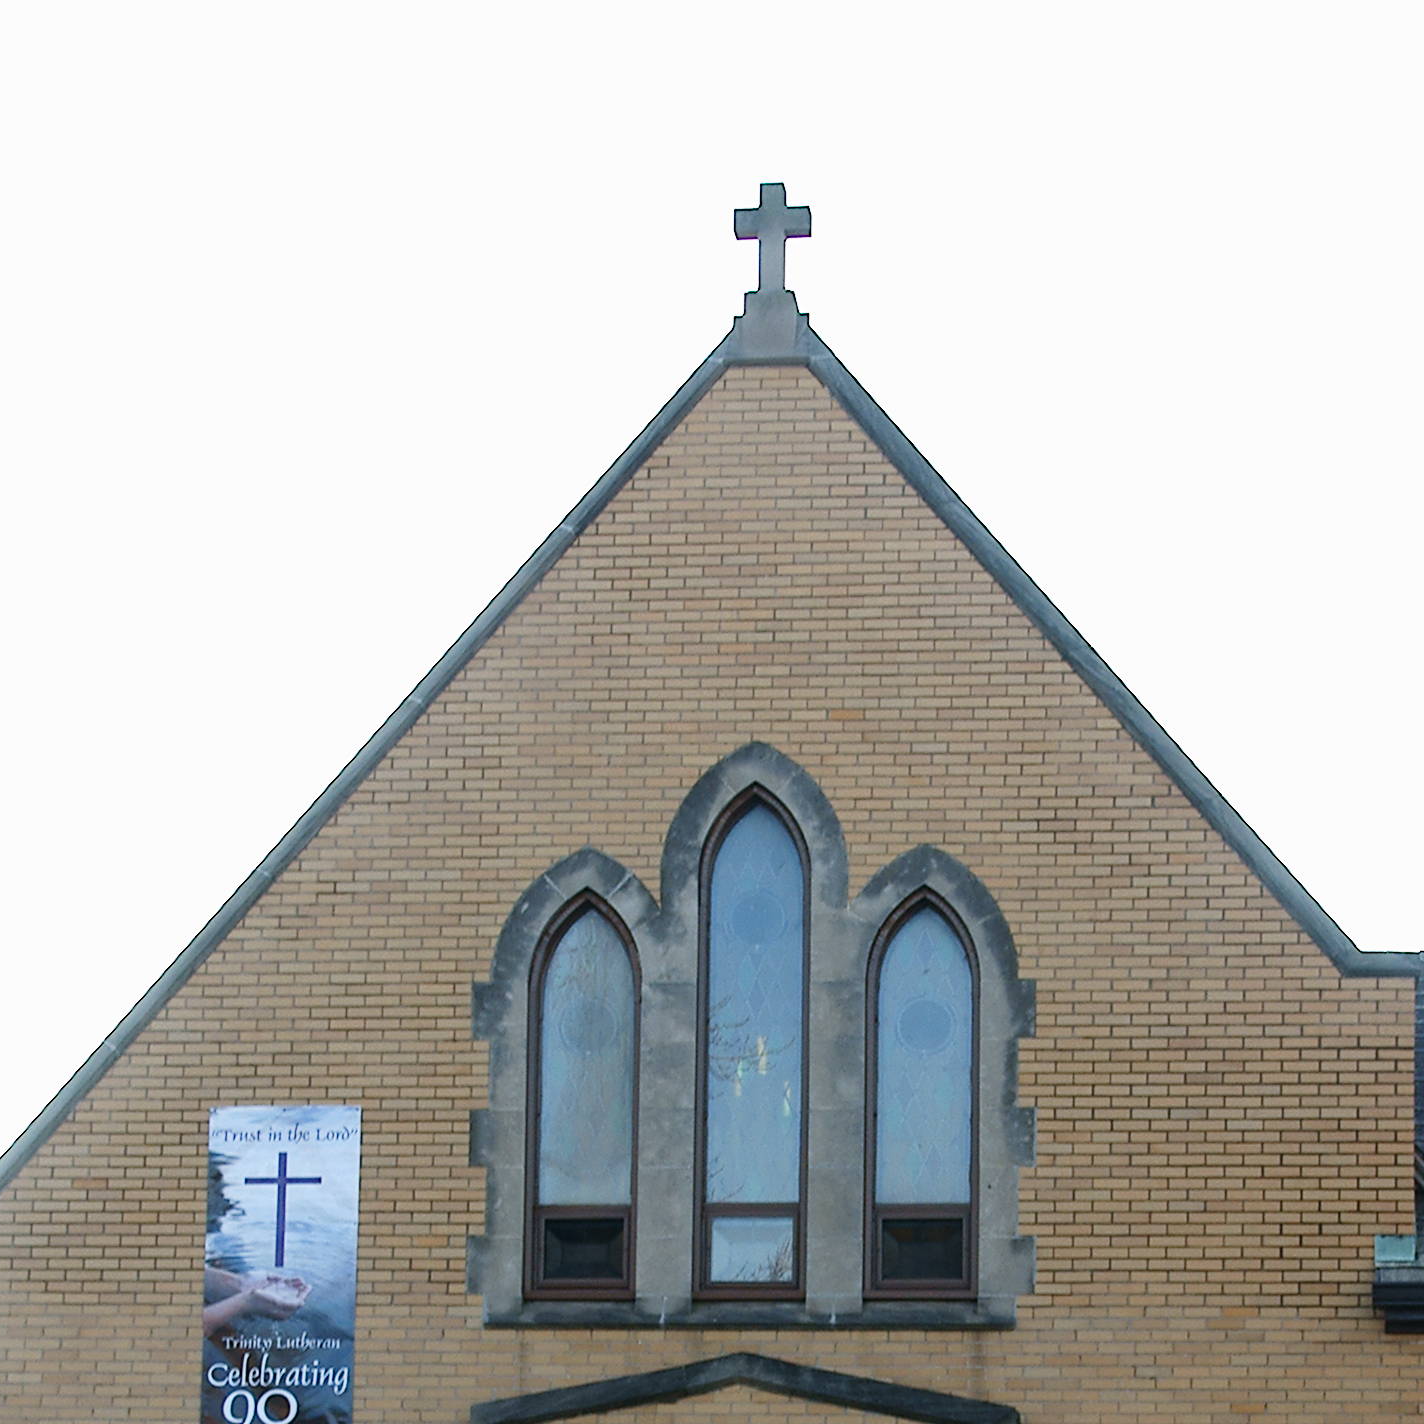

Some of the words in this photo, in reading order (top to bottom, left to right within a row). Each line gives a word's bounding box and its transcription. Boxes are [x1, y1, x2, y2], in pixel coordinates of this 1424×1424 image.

[268, 1127, 283, 1141] in
[288, 1122, 311, 1144] the
[222, 1333, 273, 1352] Trinity
[276, 1331, 341, 1351] Lutheran
[207, 1352, 349, 1396] Celebrating
